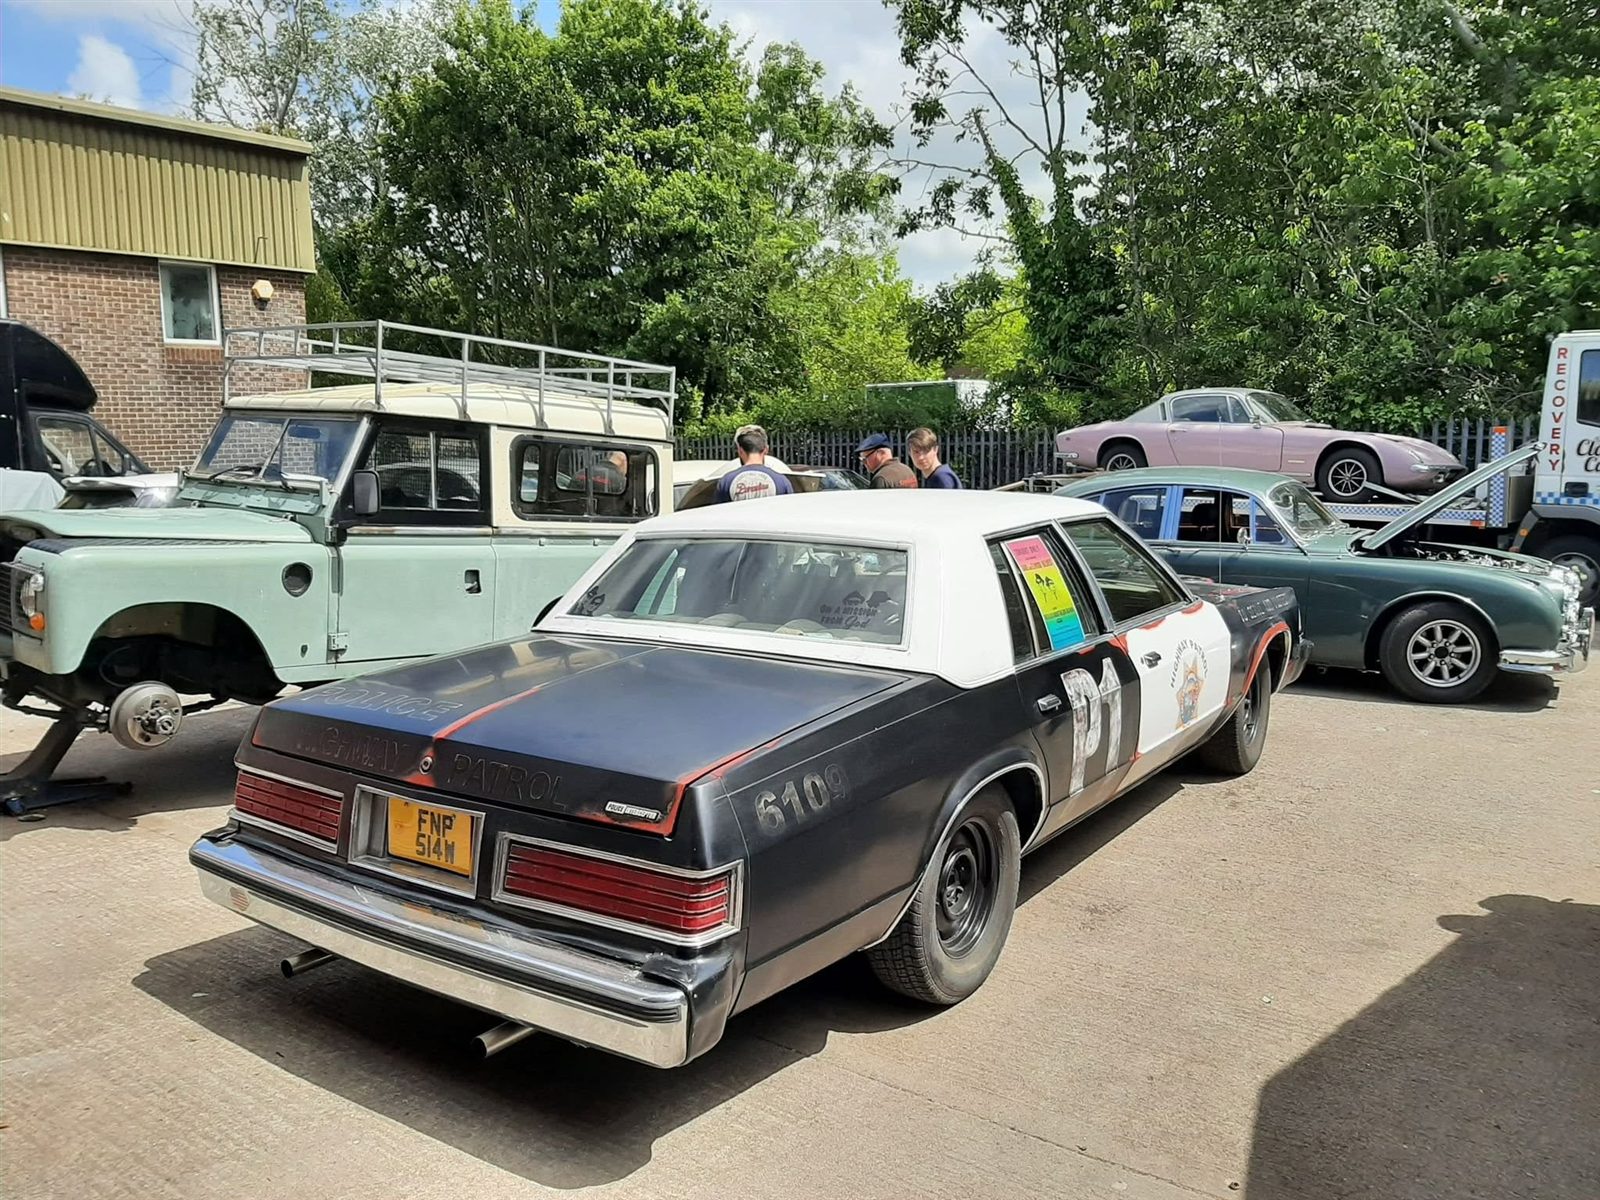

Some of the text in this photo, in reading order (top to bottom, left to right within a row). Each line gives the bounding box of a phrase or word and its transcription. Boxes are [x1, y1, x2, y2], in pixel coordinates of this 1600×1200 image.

[1549, 347, 1568, 471] RECOVERY
[1170, 639, 1208, 688] HIGHWAY PATROL
[301, 685, 464, 722] POLICE
[446, 753, 568, 812] PATROL
[754, 763, 849, 837] 6109
[418, 808, 456, 838] FNP
[415, 831, 455, 865] 514W
